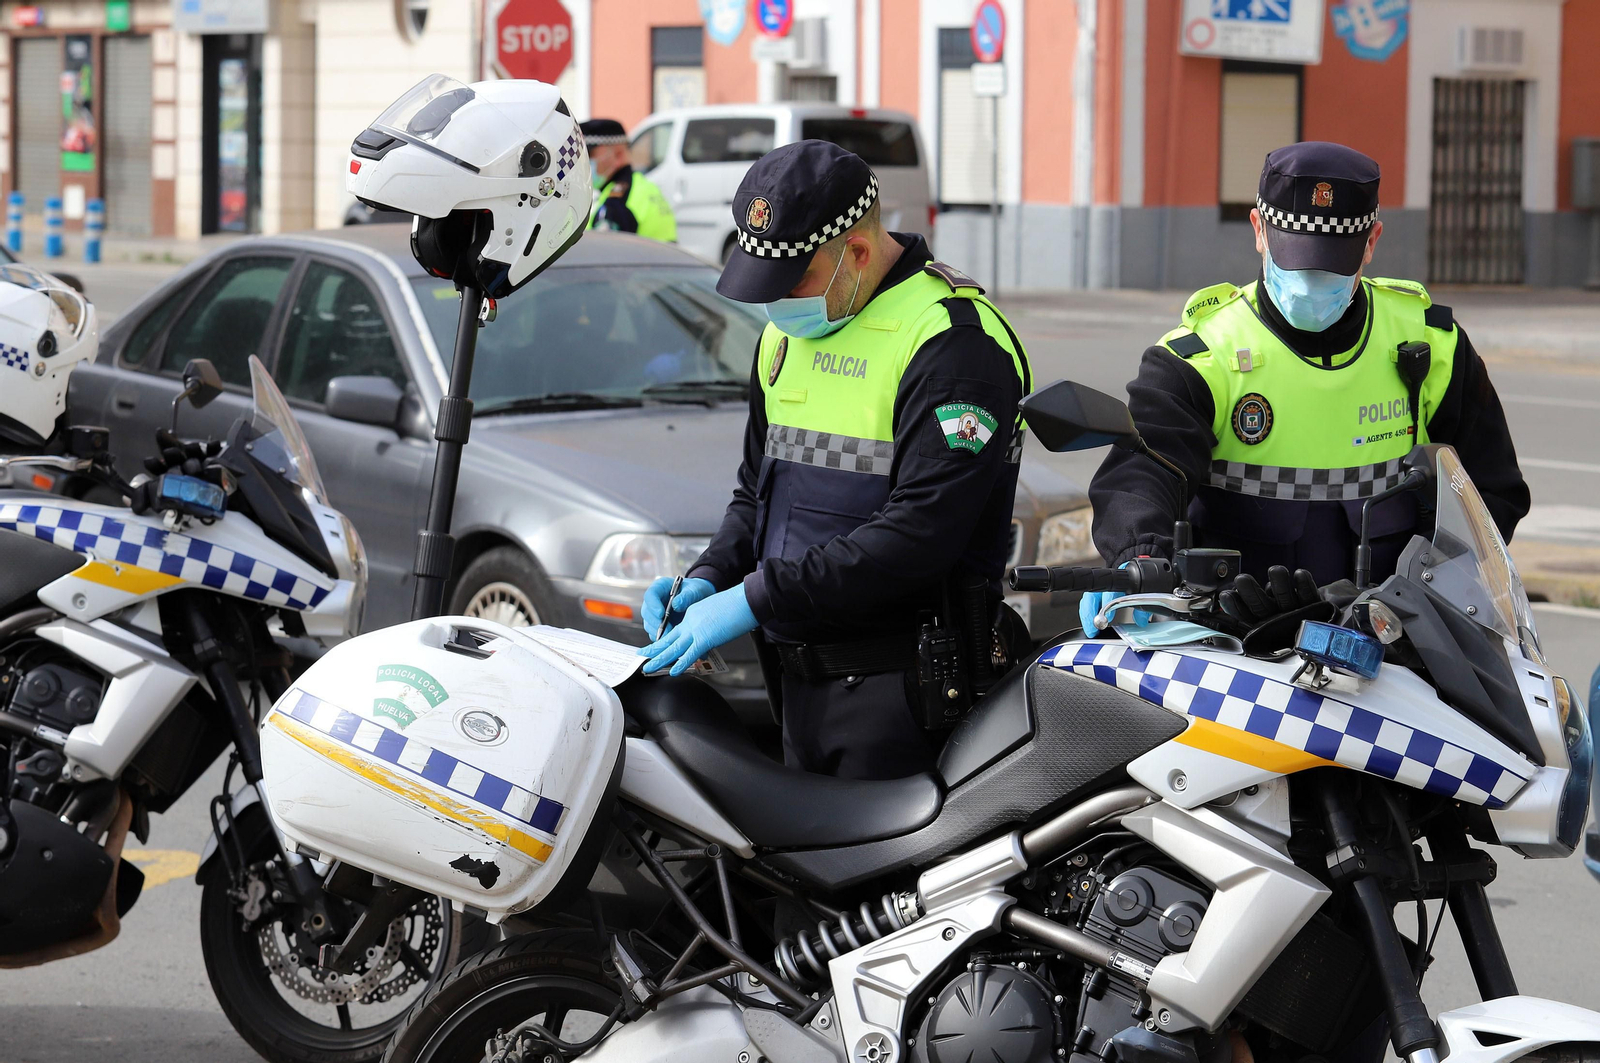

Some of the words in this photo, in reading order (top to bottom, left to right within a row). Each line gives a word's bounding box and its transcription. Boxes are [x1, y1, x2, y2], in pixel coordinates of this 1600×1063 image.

[501, 24, 570, 54] STOP
[1186, 296, 1220, 318] HUELVA
[812, 351, 868, 379] POLICIA
[941, 404, 974, 413] POLICIA
[976, 408, 995, 424] LOCAL
[953, 442, 976, 451] HUELVA
[1366, 431, 1393, 443] AGENTE
[378, 668, 416, 680] POLICIA
[418, 676, 444, 703] LOCAL
[377, 701, 409, 721] HUELVA
